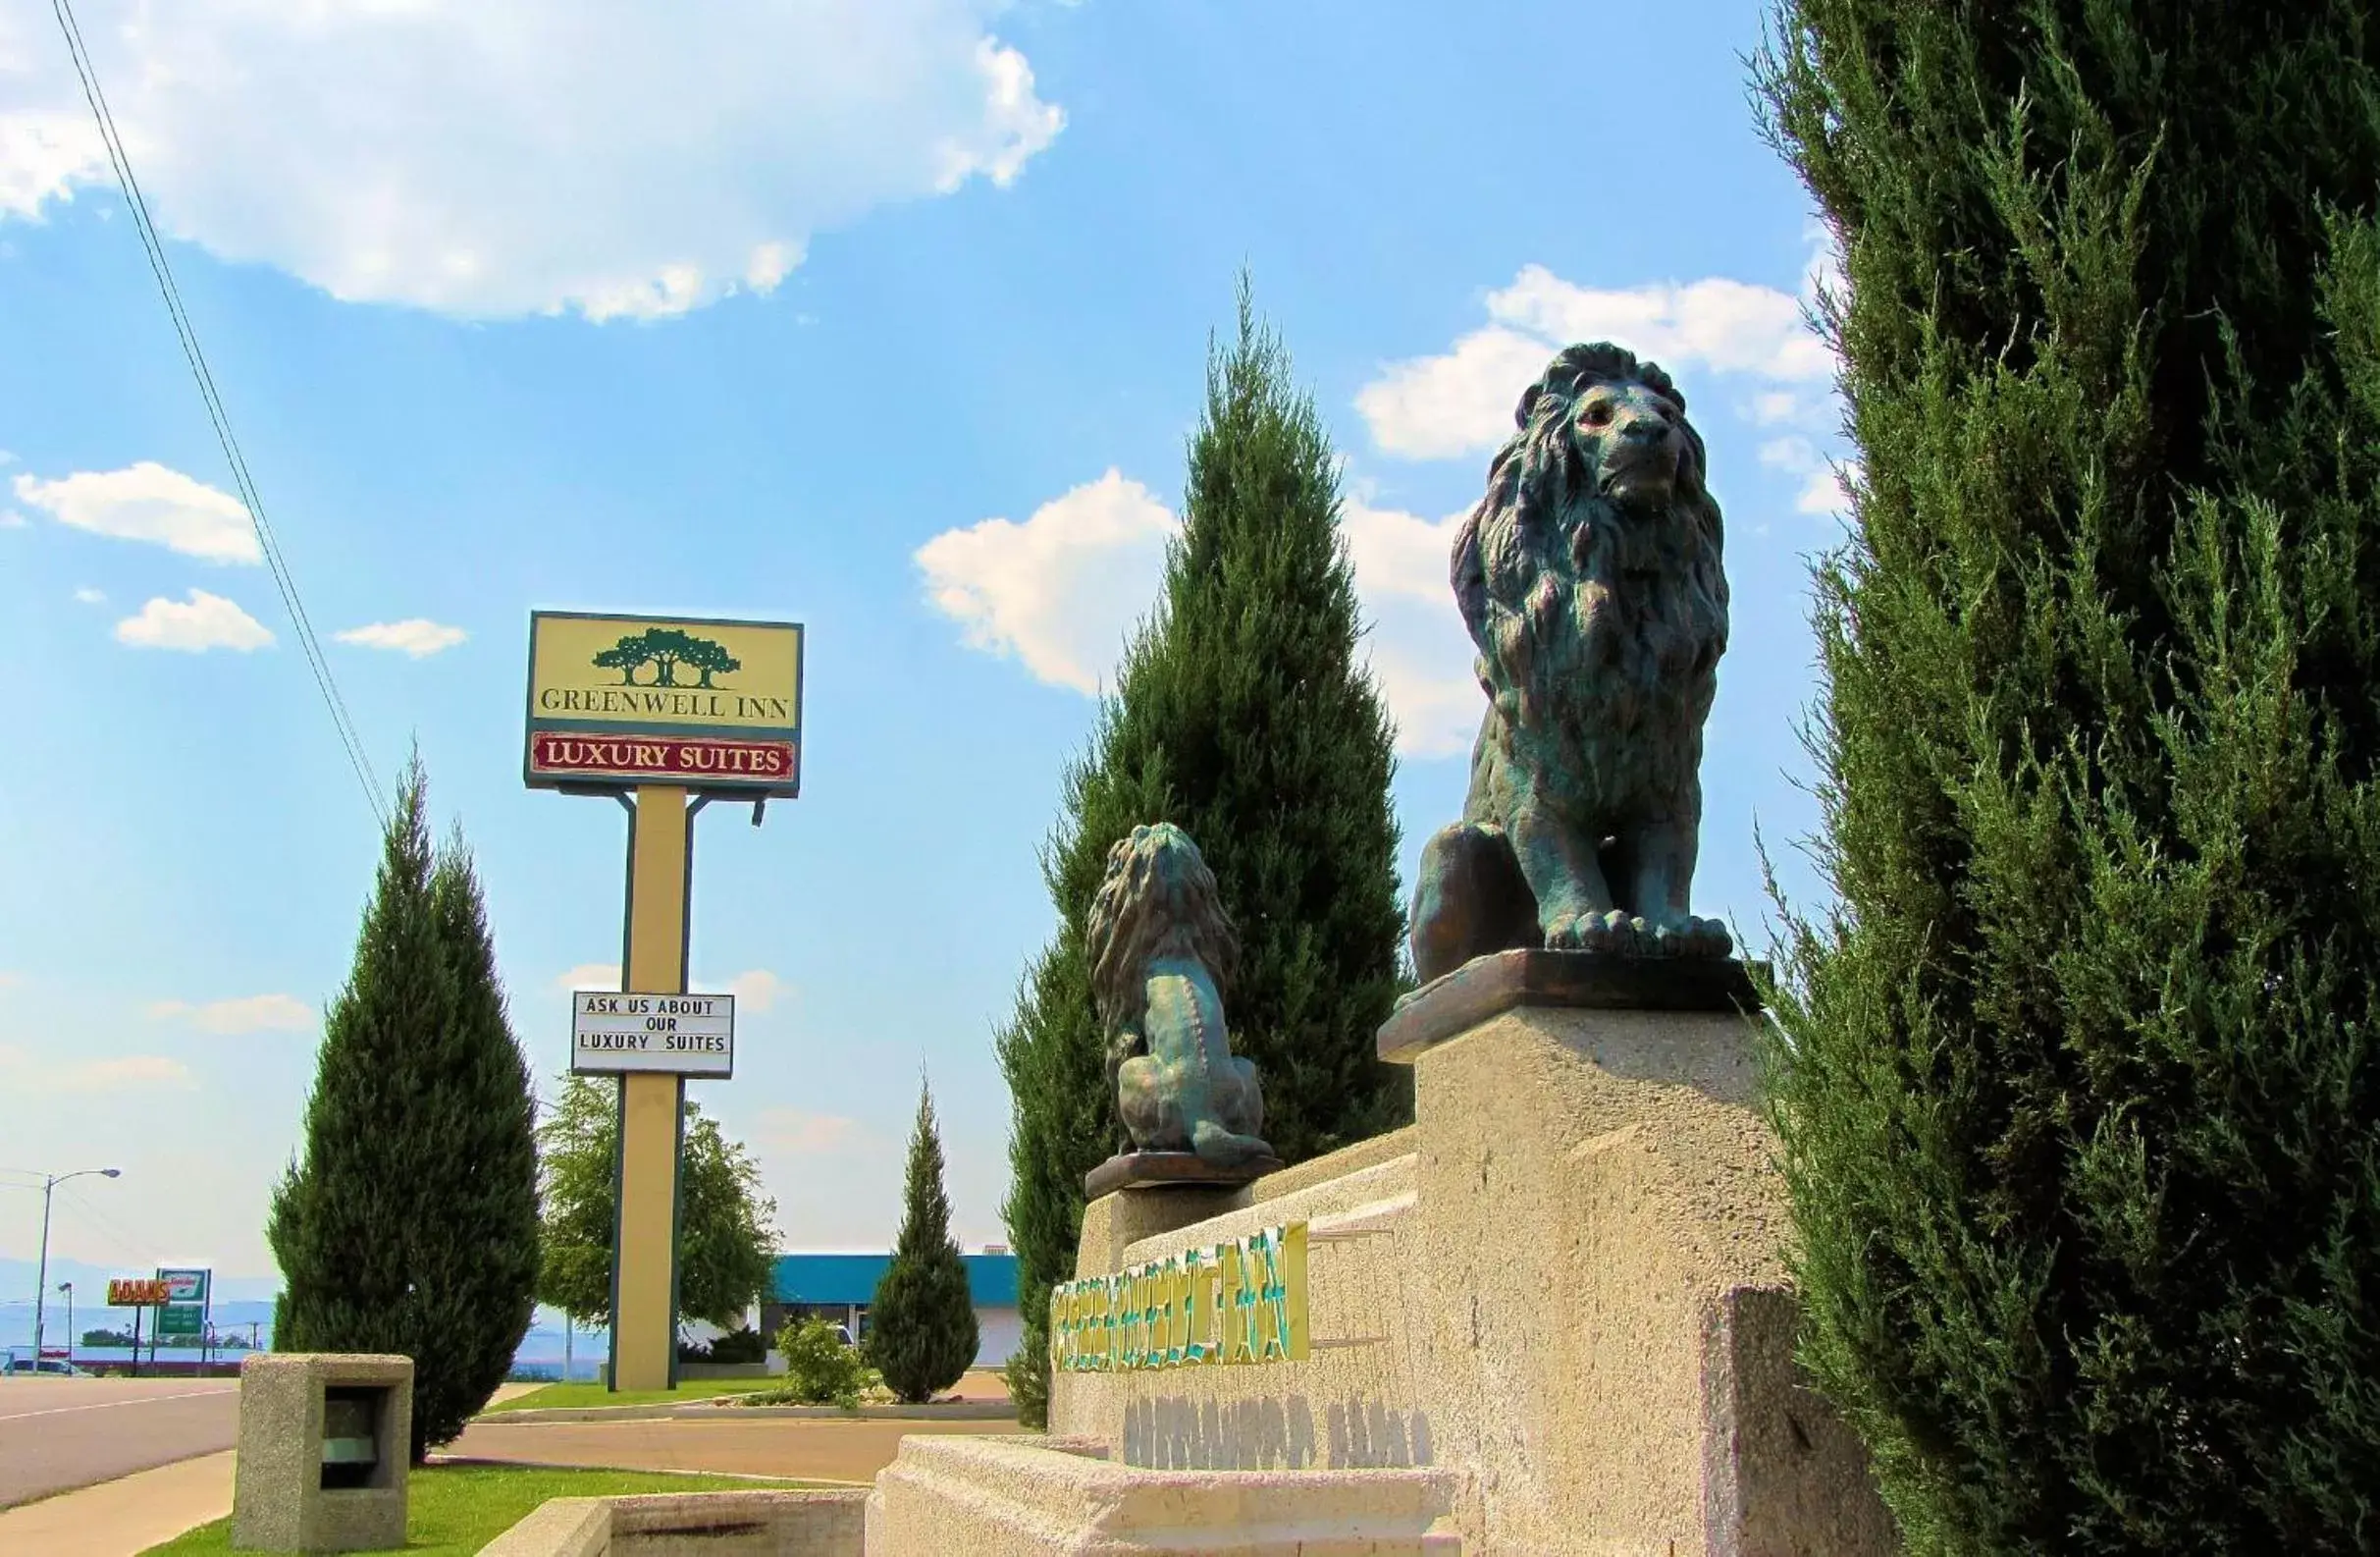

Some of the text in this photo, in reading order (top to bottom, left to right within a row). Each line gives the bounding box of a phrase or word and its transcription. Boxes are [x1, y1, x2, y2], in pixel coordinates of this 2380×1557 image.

[540, 687, 789, 720] GREENWELL INN
[546, 741, 781, 772] LUXURY SUITES
[586, 997, 714, 1015] ASK US ABOUT
[646, 1017, 677, 1031] OUR
[580, 1034, 724, 1051] LUXURY SUITES
